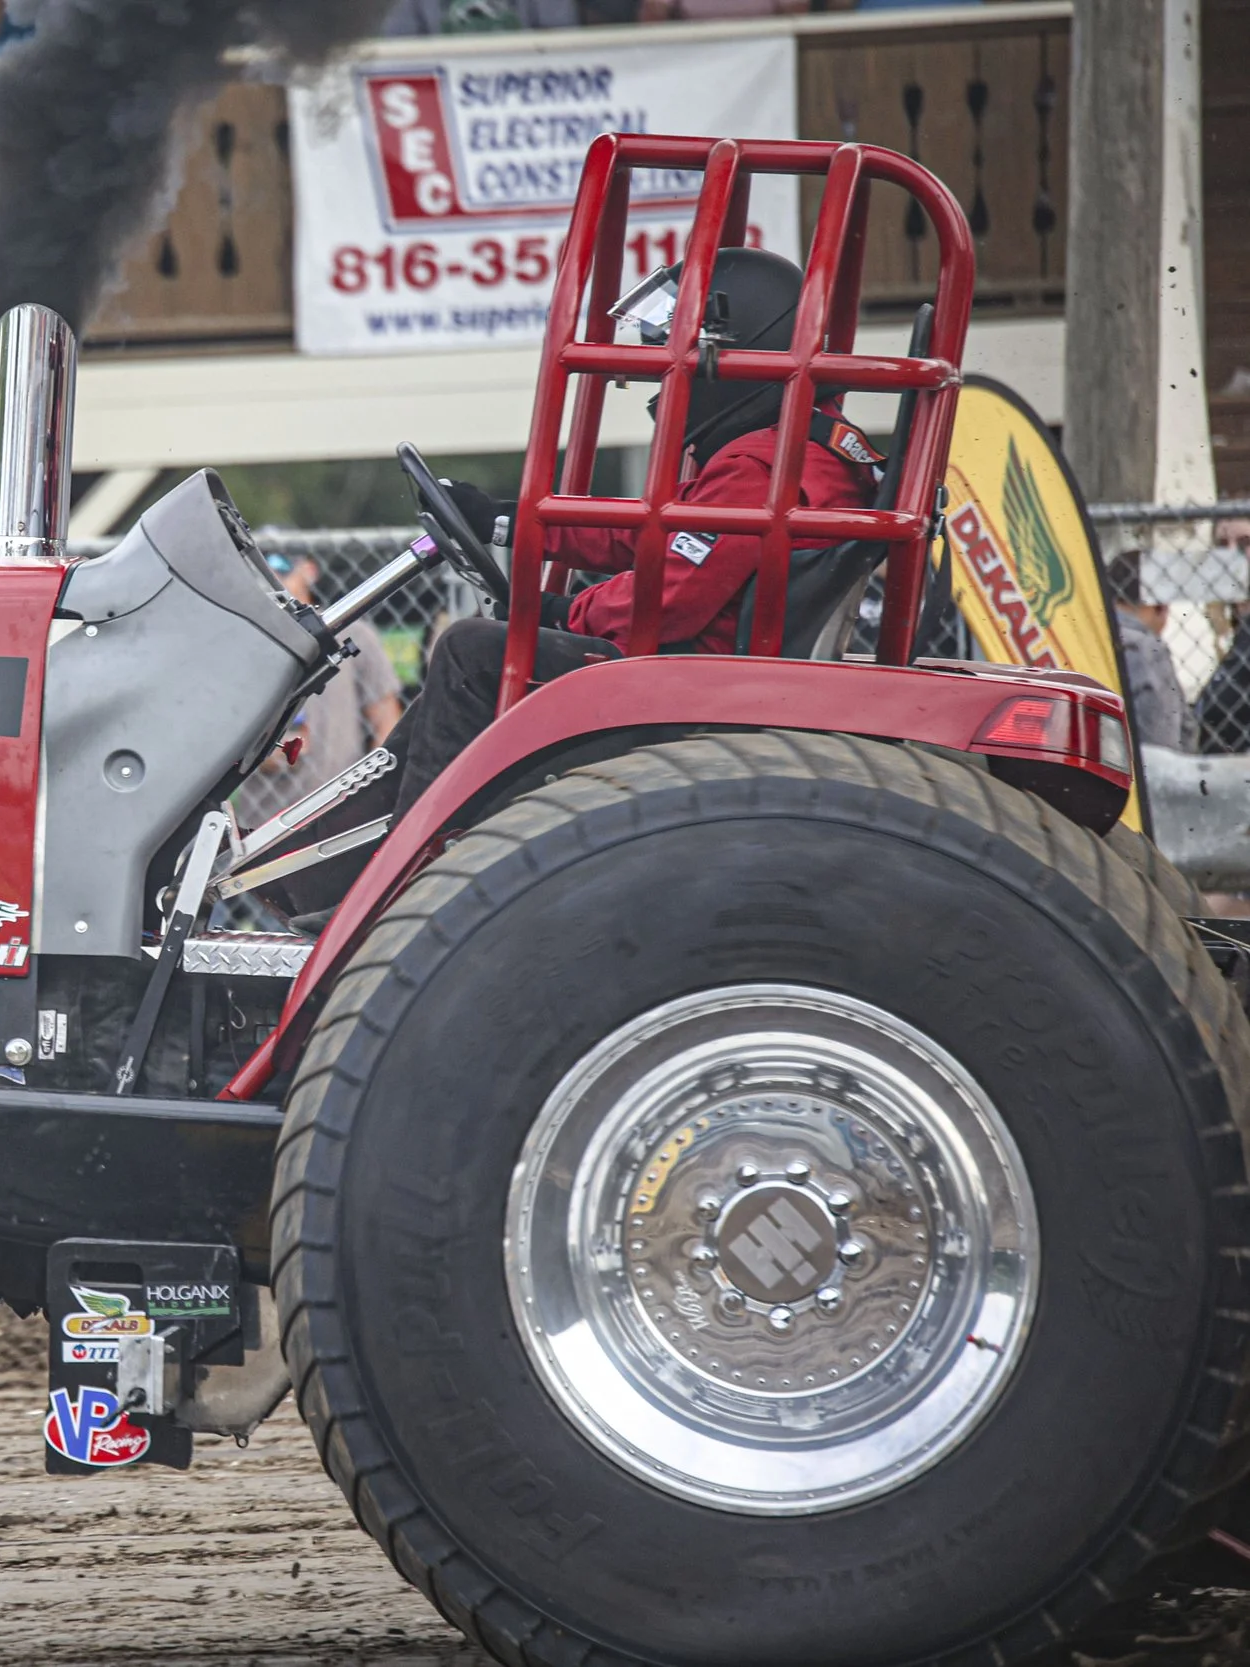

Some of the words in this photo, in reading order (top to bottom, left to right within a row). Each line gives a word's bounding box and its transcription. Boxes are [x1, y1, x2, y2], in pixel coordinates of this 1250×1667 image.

[459, 66, 614, 106] SUPERIOR
[146, 1285, 231, 1301] HOLGANIX
[81, 1319, 139, 1332] DALB
[88, 1347, 119, 1360] TIT
[50, 1385, 120, 1462] VP
[92, 1433, 144, 1457] Racing
